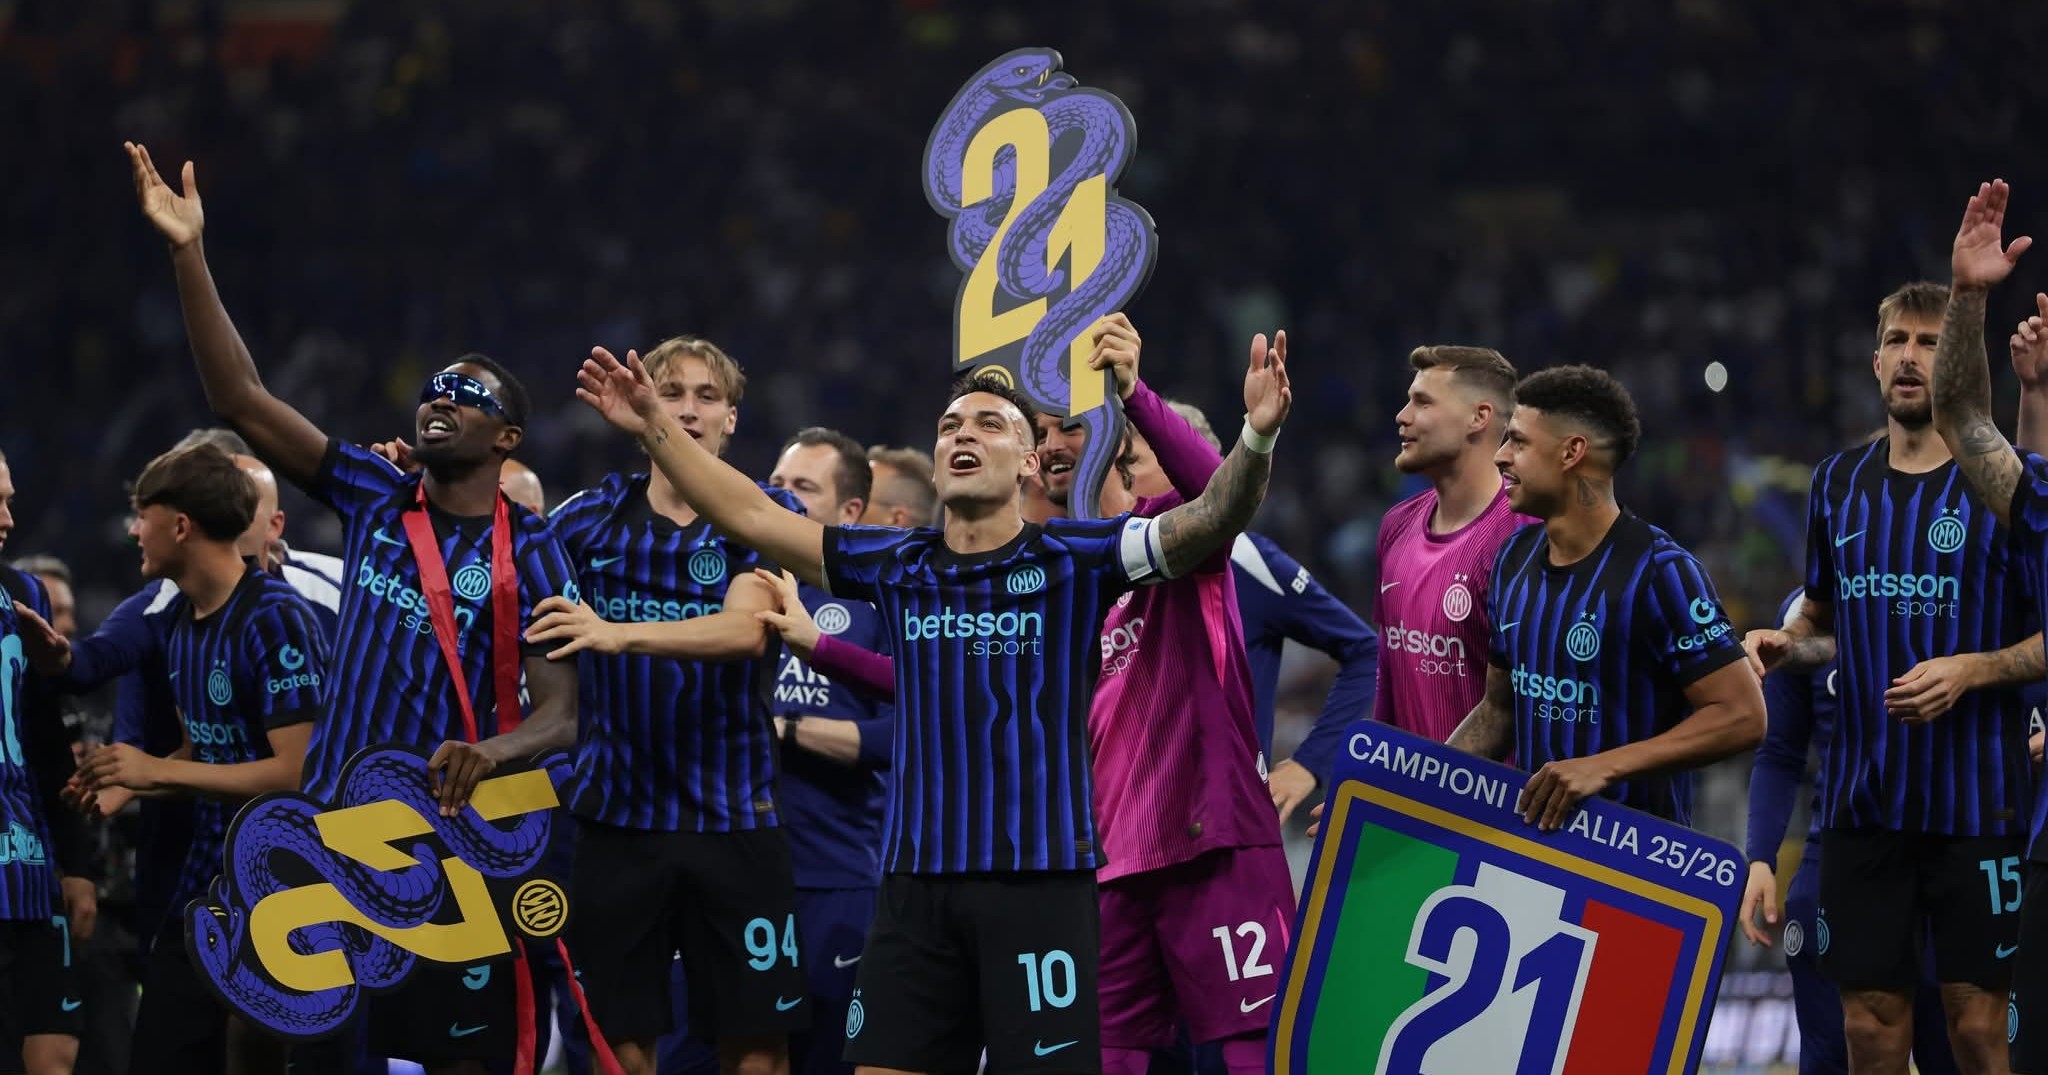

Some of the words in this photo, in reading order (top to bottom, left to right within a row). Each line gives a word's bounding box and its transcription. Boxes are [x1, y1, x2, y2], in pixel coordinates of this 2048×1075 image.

[960, 107, 1106, 417] 21
[357, 556, 474, 629] betssn
[1838, 566, 1959, 600] betsson
[1891, 600, 1958, 619] .sport
[905, 606, 1042, 641] betsson
[967, 637, 1041, 660] .sport
[1534, 703, 1599, 724] .sport
[1348, 732, 1508, 810] CAMPIONI
[1646, 835, 1738, 888] 25/26
[1979, 856, 2023, 915] 15
[744, 913, 799, 971] 94
[1212, 920, 1274, 982] 12
[1017, 949, 1077, 1012] 10
[1380, 891, 1592, 1075] 21
